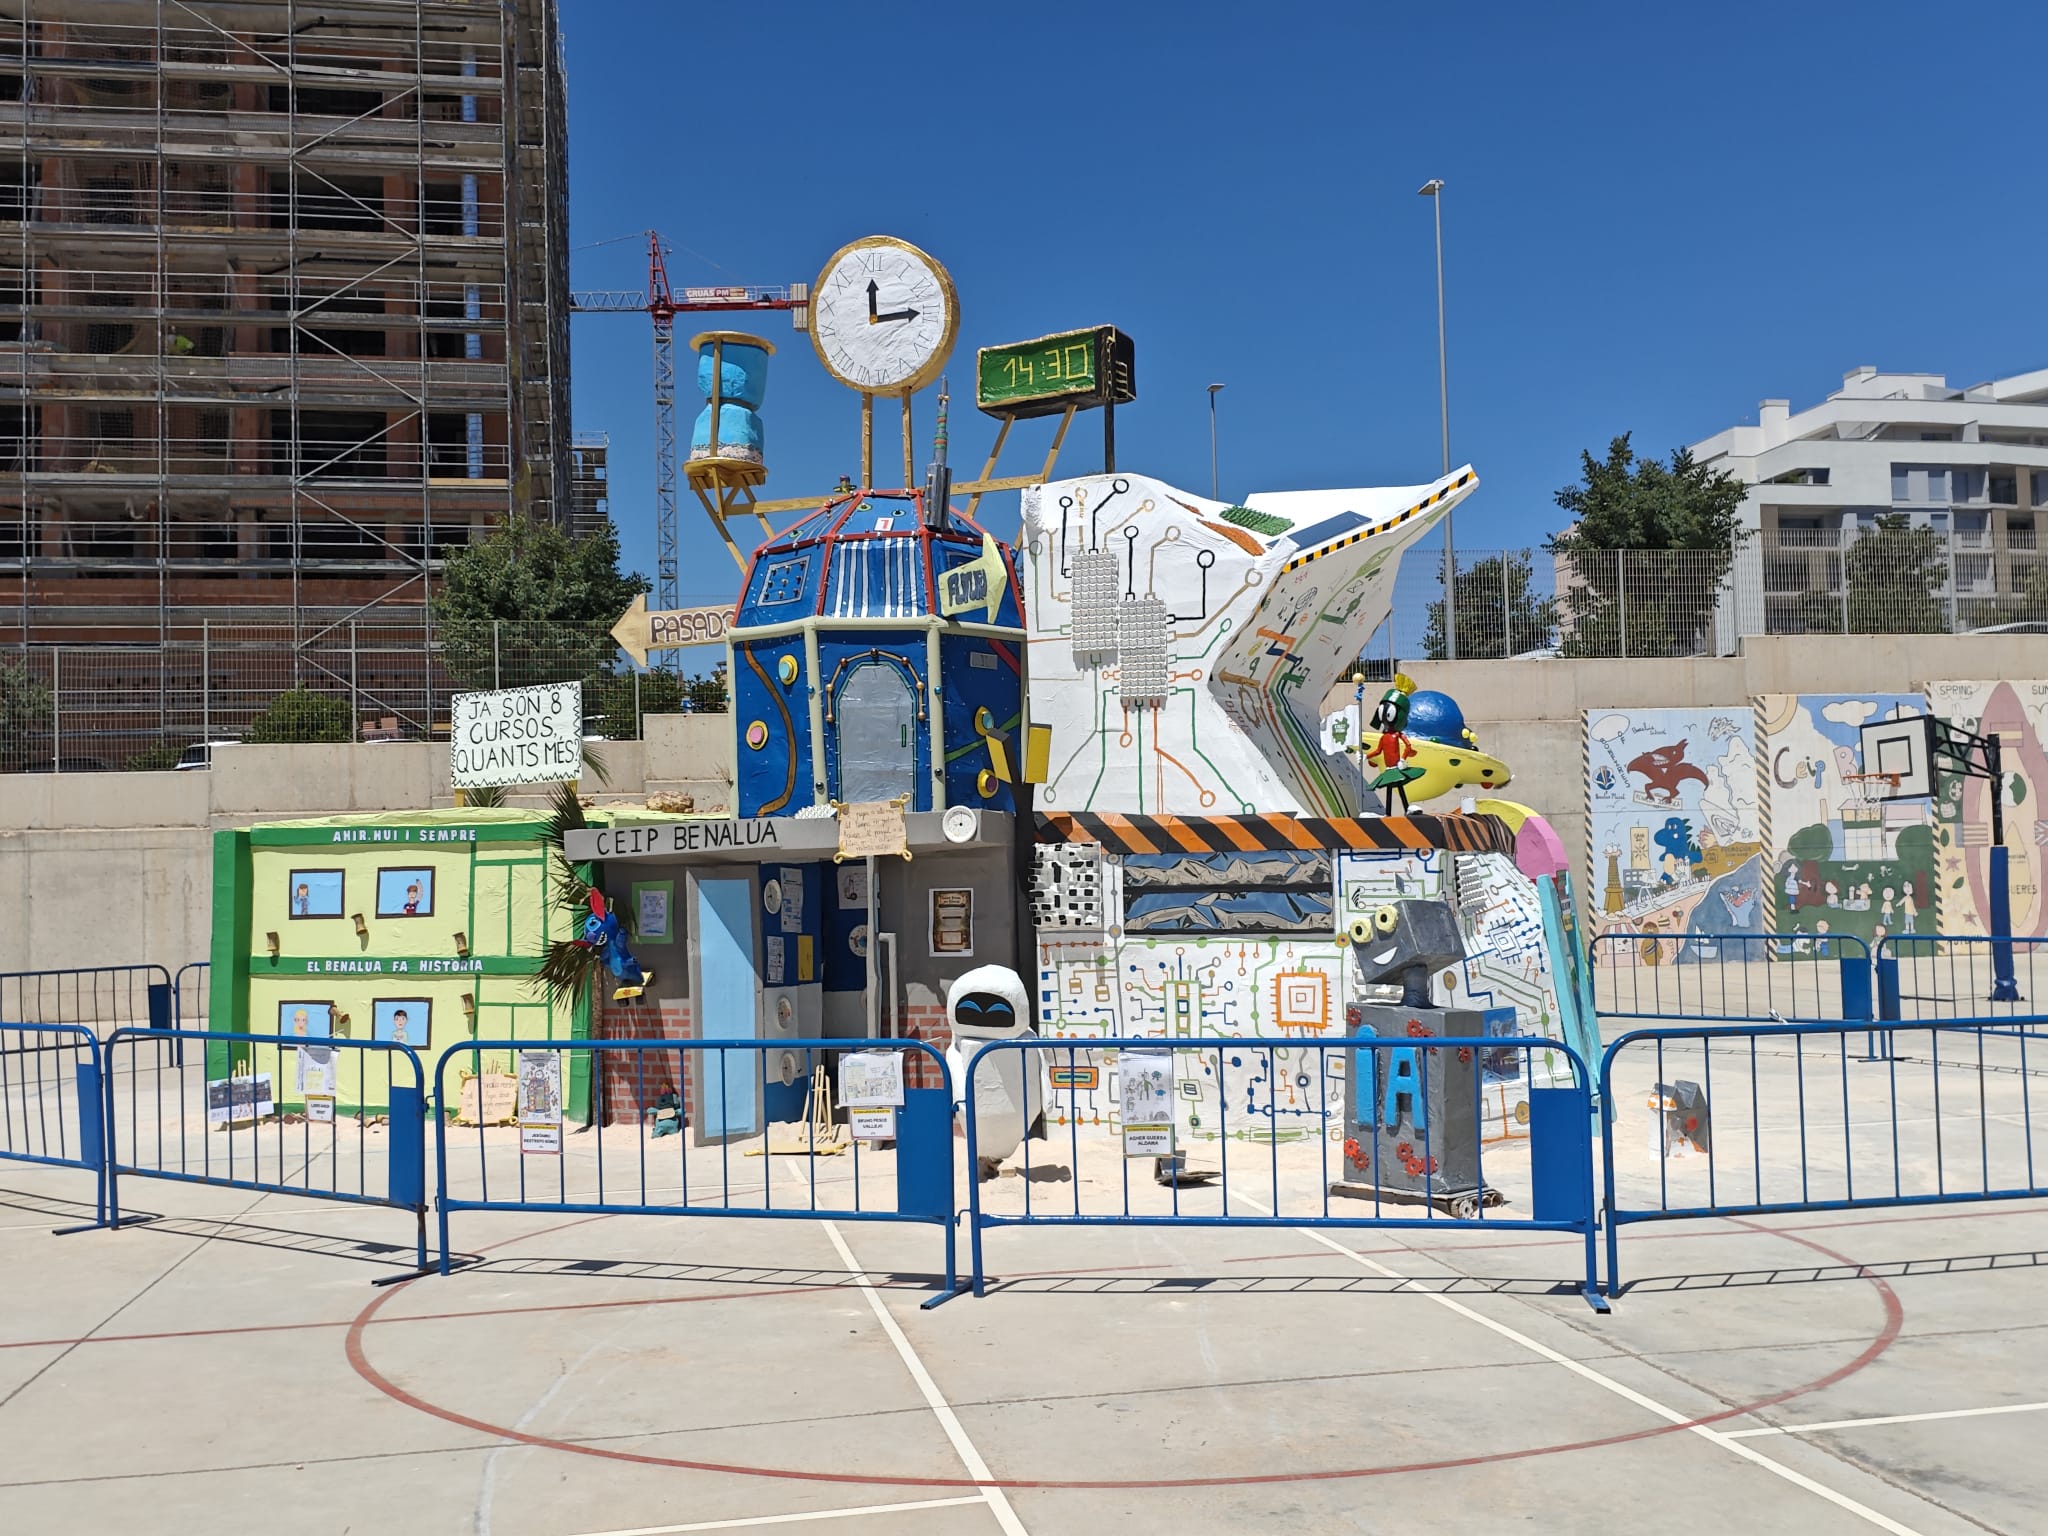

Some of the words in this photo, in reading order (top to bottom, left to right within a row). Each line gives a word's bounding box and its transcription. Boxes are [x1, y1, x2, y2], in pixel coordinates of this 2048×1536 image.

[716, 289, 729, 297] PM
[1003, 343, 1088, 387] 14:30
[1940, 685, 1973, 695] SPRING
[468, 701, 491, 720] JA
[551, 691, 562, 714] 8
[469, 716, 557, 744] CURSOS,
[456, 742, 539, 773] QUANTS
[544, 736, 580, 765] MÉS?
[1774, 746, 1826, 789] Ceip
[405, 830, 410, 841] I
[419, 829, 476, 842] SEMPRE
[597, 828, 658, 856] CEIP
[674, 819, 777, 850] BENALÚA
[307, 961, 321, 973] EL
[325, 960, 382, 973] BENALUA
[392, 961, 408, 973] FA
